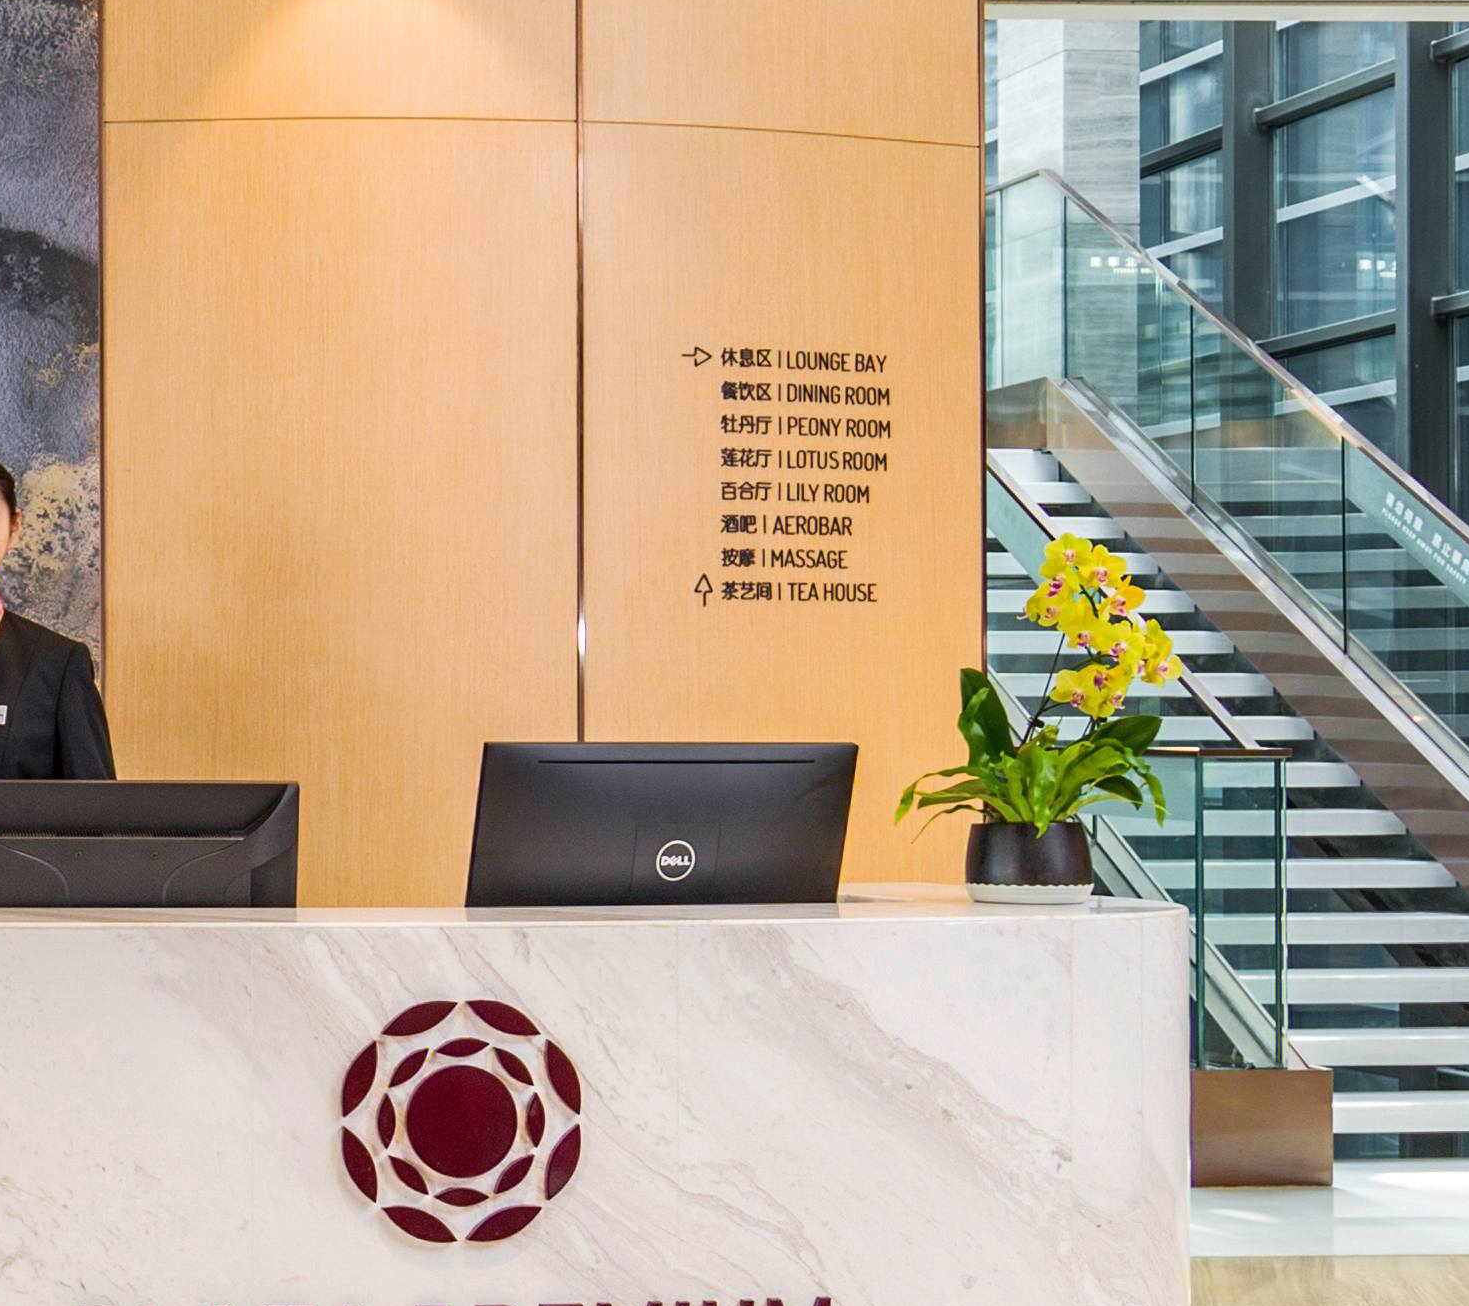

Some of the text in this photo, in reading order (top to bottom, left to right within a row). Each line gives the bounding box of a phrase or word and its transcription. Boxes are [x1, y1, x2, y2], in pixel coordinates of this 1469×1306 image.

[720, 347, 887, 373] 休息区 LOUNGE BAY
[720, 381, 890, 406] 餐饮区 DINING ROOM
[720, 414, 891, 439] 牡丹厅 PEONY ROOM
[720, 448, 888, 472] 莲花厅 LOTUS ROOM
[720, 481, 870, 503] 百合厅 LILY ROOM
[720, 514, 853, 536] 酒吧 AEROBAR
[721, 547, 848, 569] 按摩 MASSAGE
[721, 580, 878, 603] 茶艺间 TEA HOUSE
[661, 855, 690, 866] DELL
